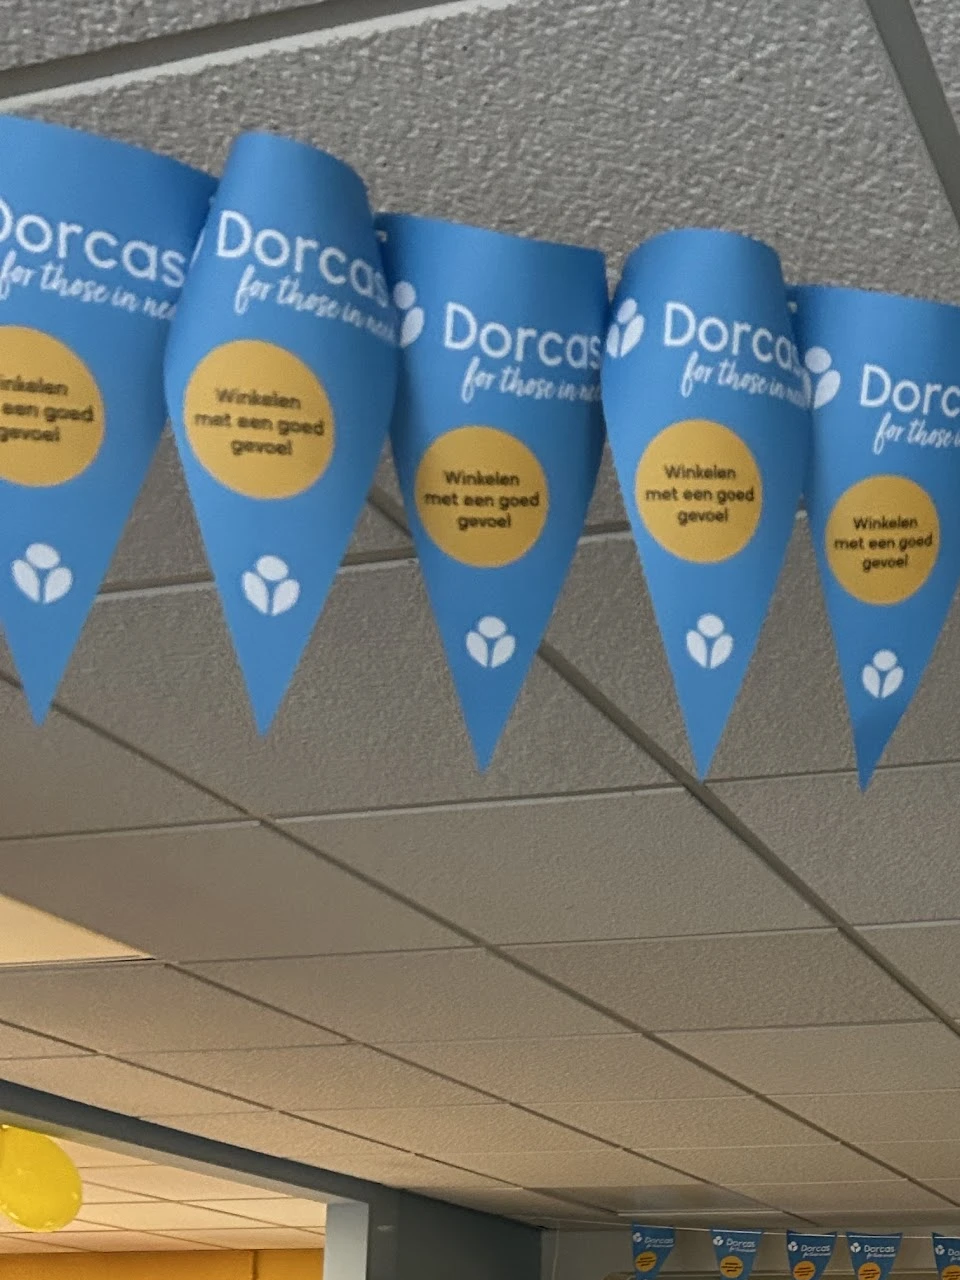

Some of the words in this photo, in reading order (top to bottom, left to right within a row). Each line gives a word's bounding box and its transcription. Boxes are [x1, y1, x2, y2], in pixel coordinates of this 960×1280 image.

[233, 264, 273, 315] for
[444, 301, 600, 370] Dorcas
[461, 356, 496, 404] for
[499, 364, 554, 400] those
[680, 350, 714, 399] for
[717, 358, 768, 396] those
[215, 388, 302, 410] Winkelen
[277, 418, 325, 437] goed
[872, 411, 904, 455] for
[907, 418, 952, 448] those
[230, 440, 293, 456] gevoel
[443, 469, 520, 486] Winkelen
[663, 464, 737, 479] Winkelen
[424, 493, 459, 506] met
[463, 495, 495, 507] een
[499, 491, 540, 511] goed
[645, 487, 679, 501] met
[683, 489, 713, 501] een
[717, 484, 755, 505] goed
[457, 513, 512, 531] gevoel
[678, 508, 729, 526] gevoel
[853, 515, 919, 530] Winkelen
[833, 537, 866, 551] met
[868, 539, 896, 550] een
[899, 532, 933, 552] goed
[862, 554, 909, 573] gevoel
[801, 1244, 831, 1252] Dorcas
[864, 1244, 896, 1253] Dorcas
